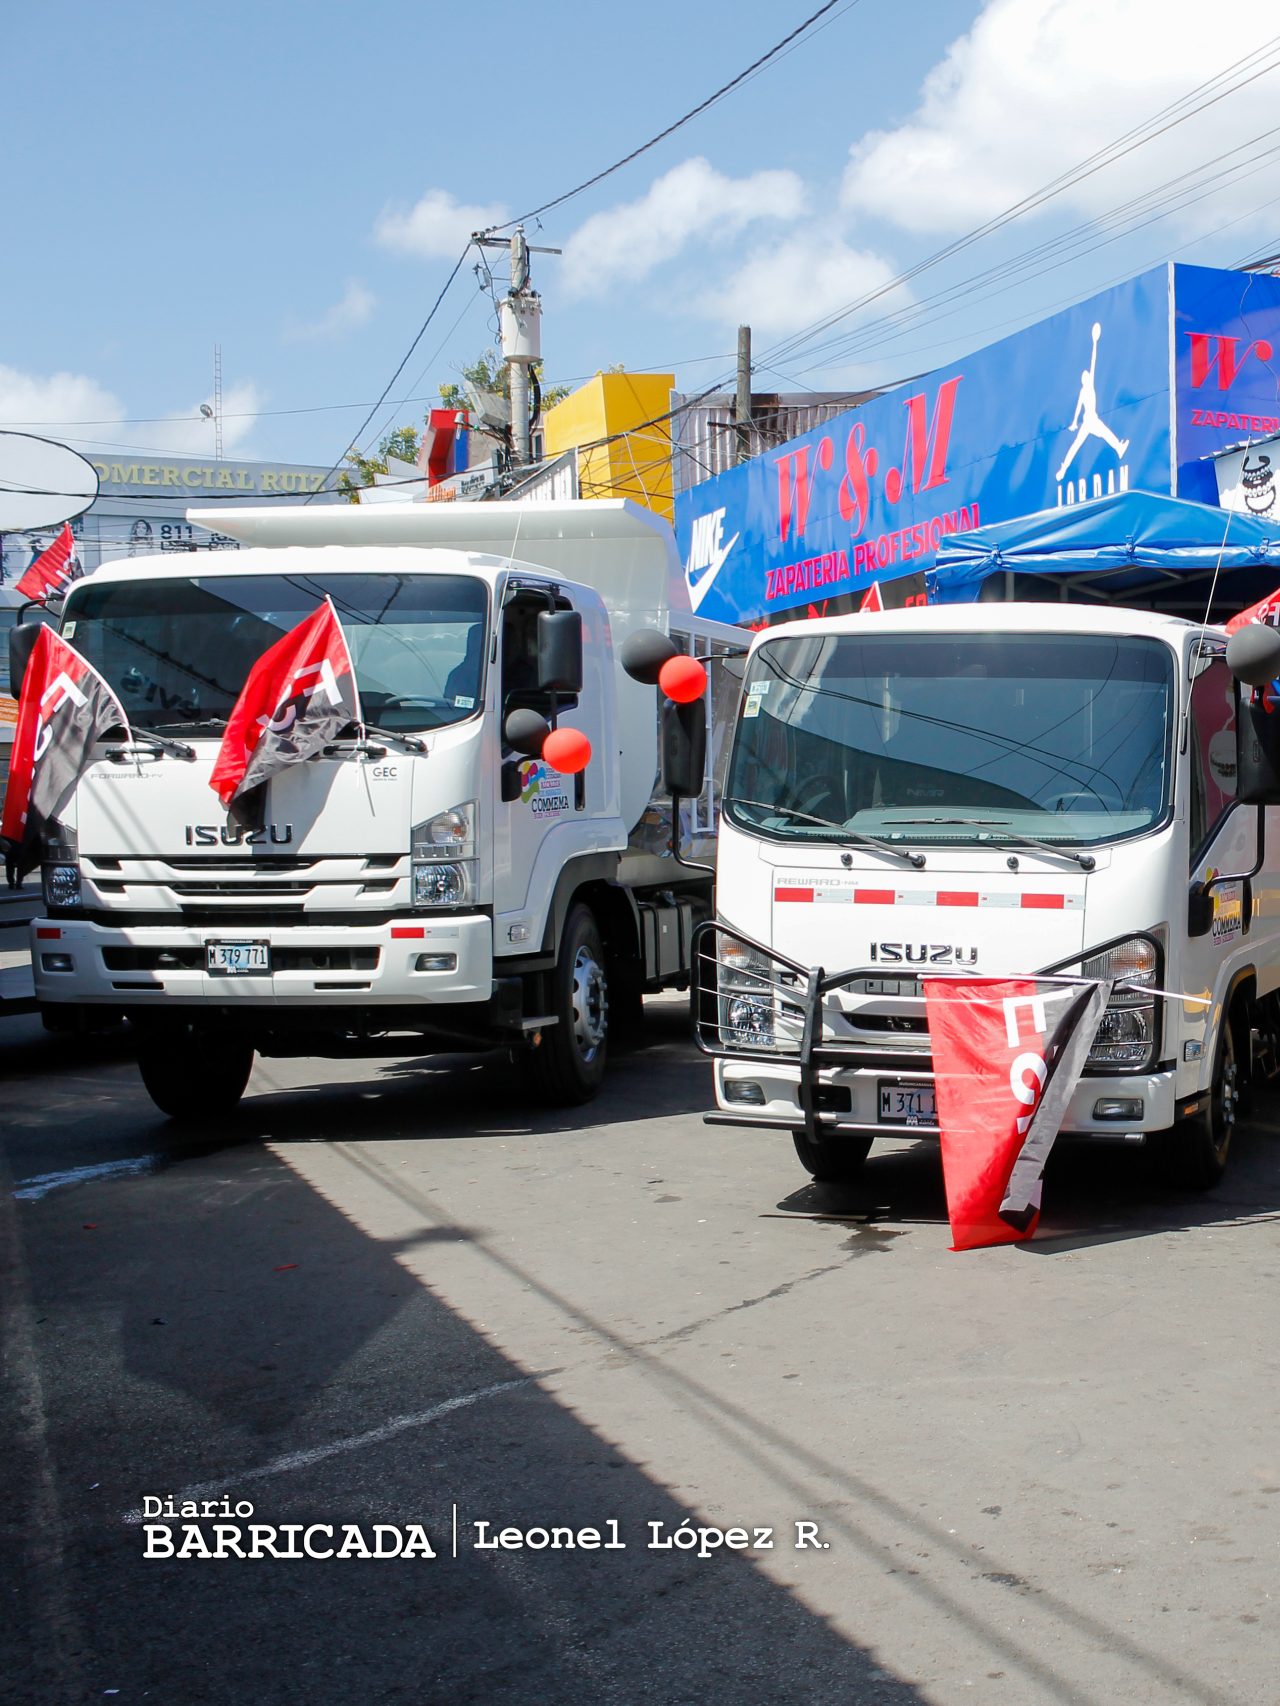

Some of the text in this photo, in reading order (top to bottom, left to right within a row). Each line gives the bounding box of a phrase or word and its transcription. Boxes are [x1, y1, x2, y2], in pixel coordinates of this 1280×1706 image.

[1184, 332, 1273, 391] W
[774, 375, 964, 543] W & M
[93, 463, 325, 492] OMERCIAL RUIZ
[160, 525, 192, 540] 811
[689, 507, 726, 573] NIKE
[765, 551, 850, 600] ZAPATERIA
[373, 767, 397, 777] GEC
[185, 824, 292, 846] ISUZU
[209, 948, 267, 965] M 379 771
[870, 941, 978, 965] ISUZU
[882, 1092, 890, 1113] M
[896, 1093, 923, 1113] 371
